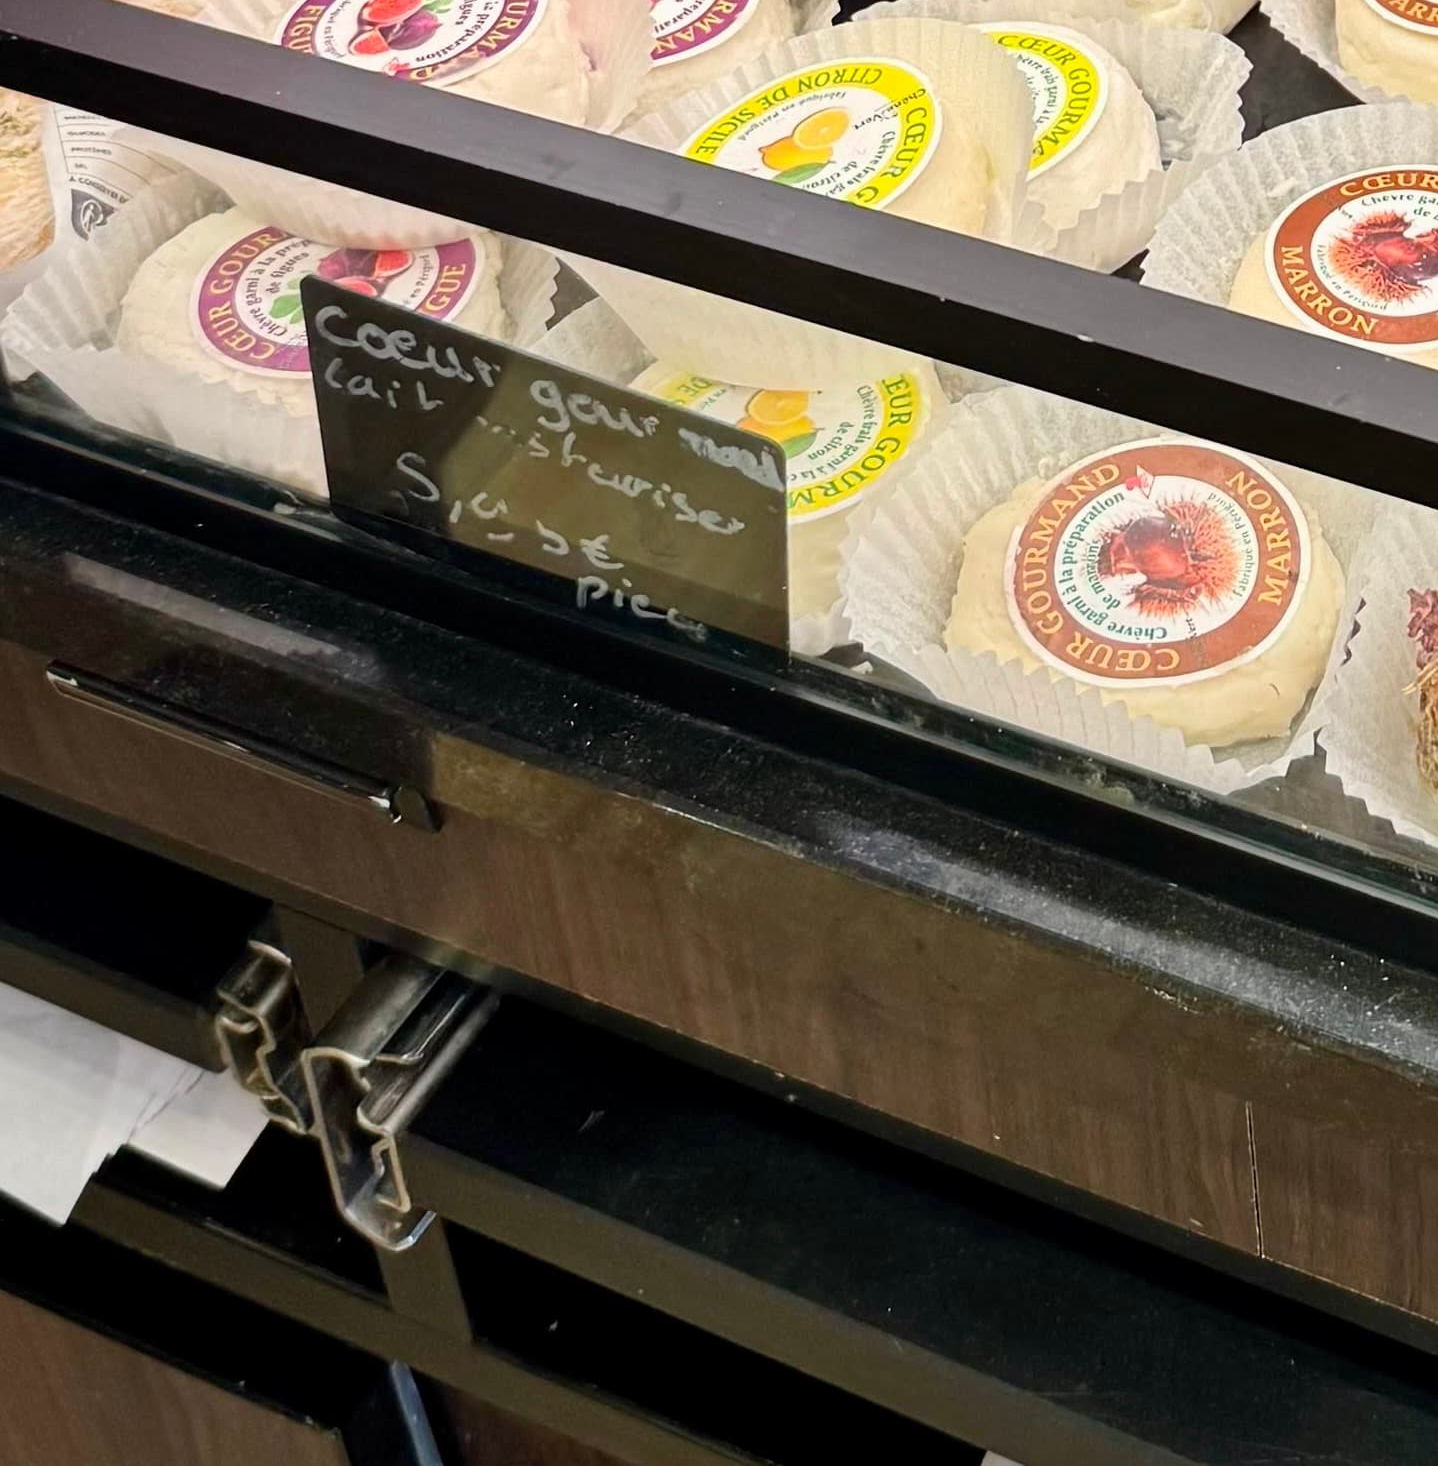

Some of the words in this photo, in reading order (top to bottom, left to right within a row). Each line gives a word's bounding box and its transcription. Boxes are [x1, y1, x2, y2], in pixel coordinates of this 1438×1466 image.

[289, 5, 326, 55] FIGU
[998, 35, 1076, 66] CŒUR
[760, 87, 789, 109] DE
[797, 68, 883, 92] CITRON
[696, 107, 755, 155] SICILE
[1032, 67, 1091, 156] GOURMA
[881, 107, 927, 178] CŒUR
[425, 263, 466, 312] GUE
[1281, 246, 1378, 336] MARRON
[209, 301, 275, 359] CŒUR
[787, 437, 900, 508] GOURM
[1022, 463, 1120, 635] GOURMAND
[1061, 492, 1125, 565] préparation
[1225, 471, 1292, 606] MARRON
[1103, 594, 1120, 610] de
[1066, 631, 1180, 672] CŒUR
[1107, 620, 1167, 640] Chèvre
